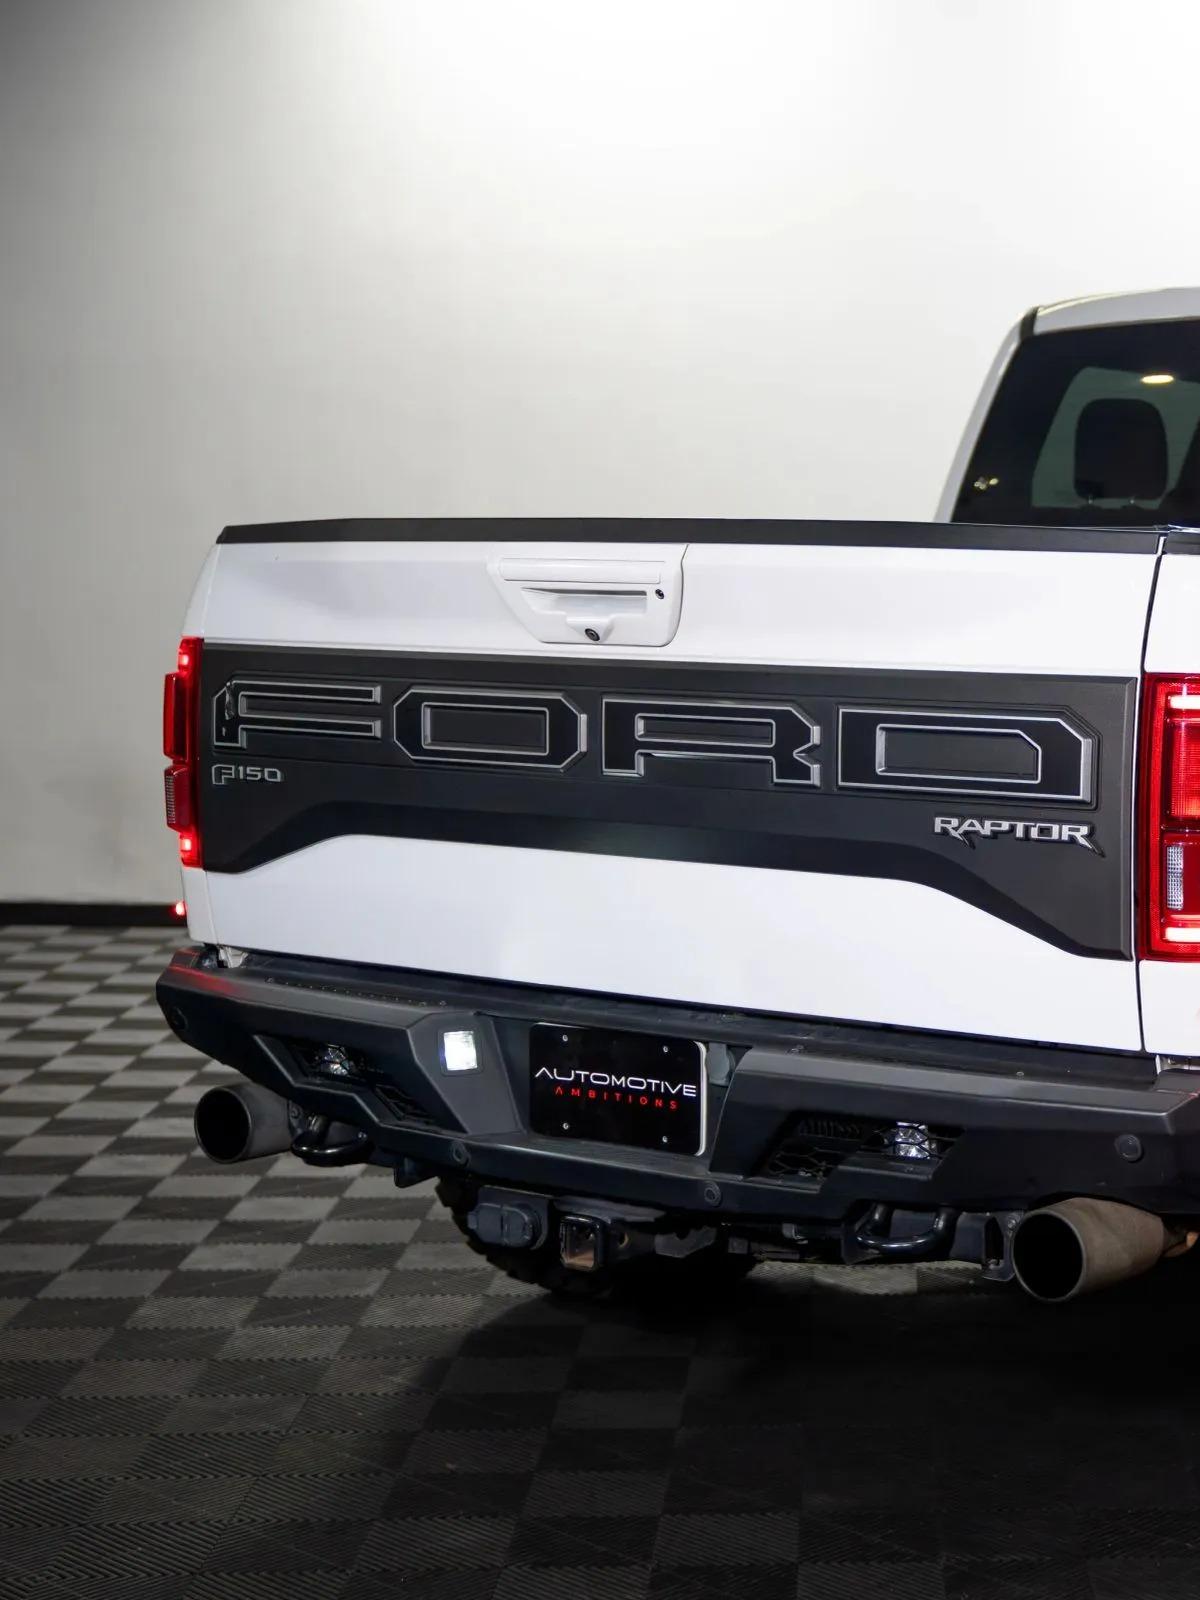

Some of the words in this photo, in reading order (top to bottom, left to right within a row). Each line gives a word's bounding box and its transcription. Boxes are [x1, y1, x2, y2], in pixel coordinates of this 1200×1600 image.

[212, 677, 1094, 803] FORD
[211, 764, 281, 785] F150
[933, 816, 1097, 852] RAPTOR
[535, 1067, 697, 1097] AUTOMOTIVE
[554, 1085, 679, 1110] AMBITIONS
